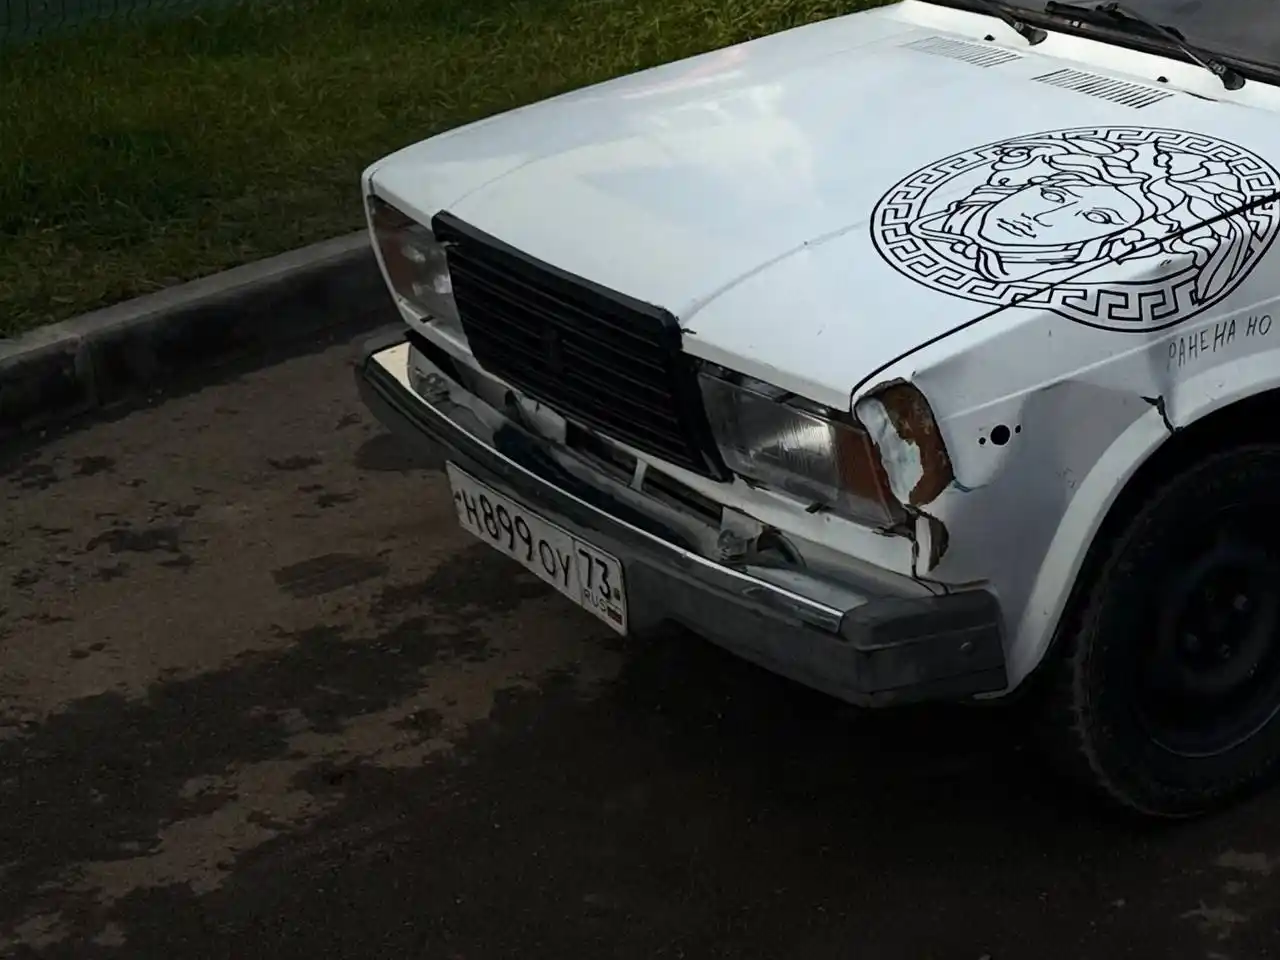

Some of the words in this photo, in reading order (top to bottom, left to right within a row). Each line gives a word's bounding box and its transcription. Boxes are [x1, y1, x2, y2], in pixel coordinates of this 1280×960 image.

[1166, 319, 1237, 372] РАНЕНА
[1245, 313, 1273, 338] НО
[583, 588, 608, 613] RUS
